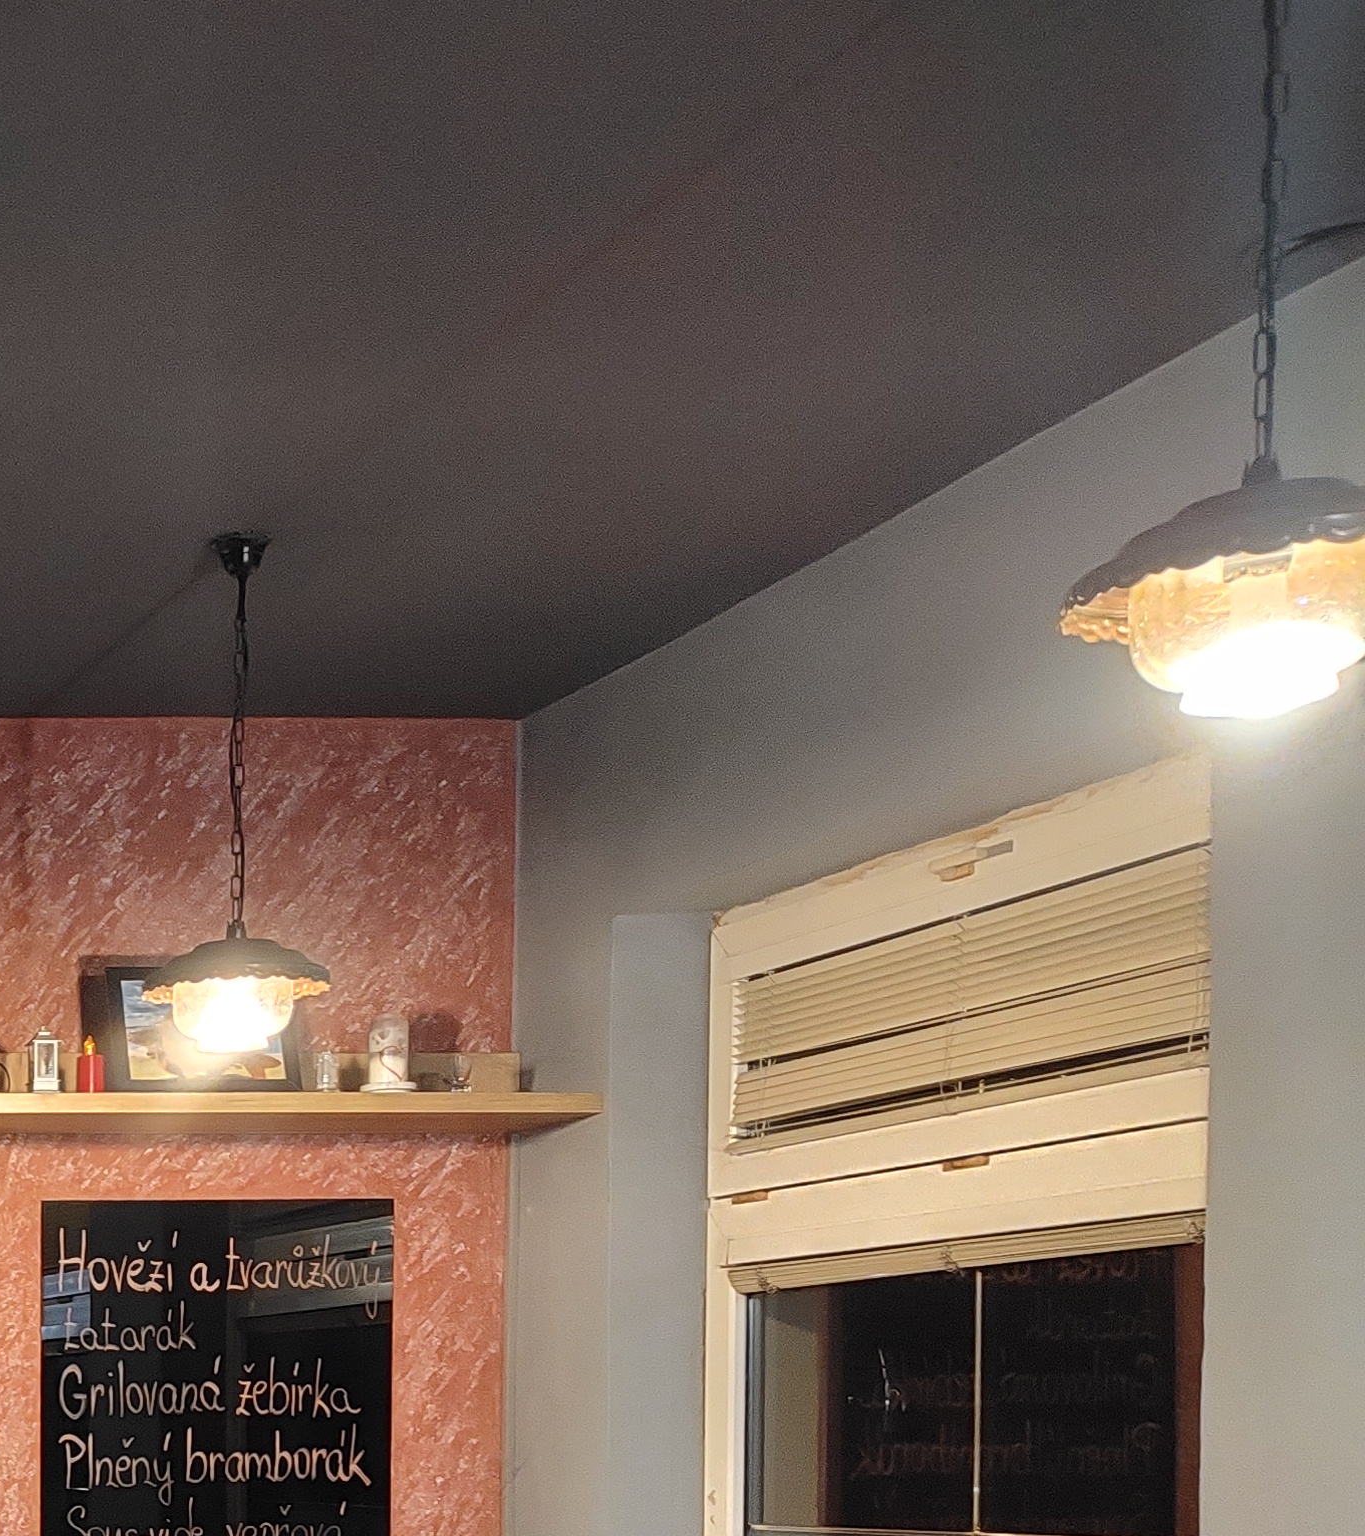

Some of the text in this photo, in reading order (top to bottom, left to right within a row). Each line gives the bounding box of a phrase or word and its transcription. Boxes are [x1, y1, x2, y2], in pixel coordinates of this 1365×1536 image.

[57, 1227, 381, 1320] Hovězí a tvarůžkový
[63, 1300, 198, 1352] tatarák
[58, 1355, 362, 1420] Grilovaná žebírka
[58, 1423, 372, 1506] Plněný bramborák
